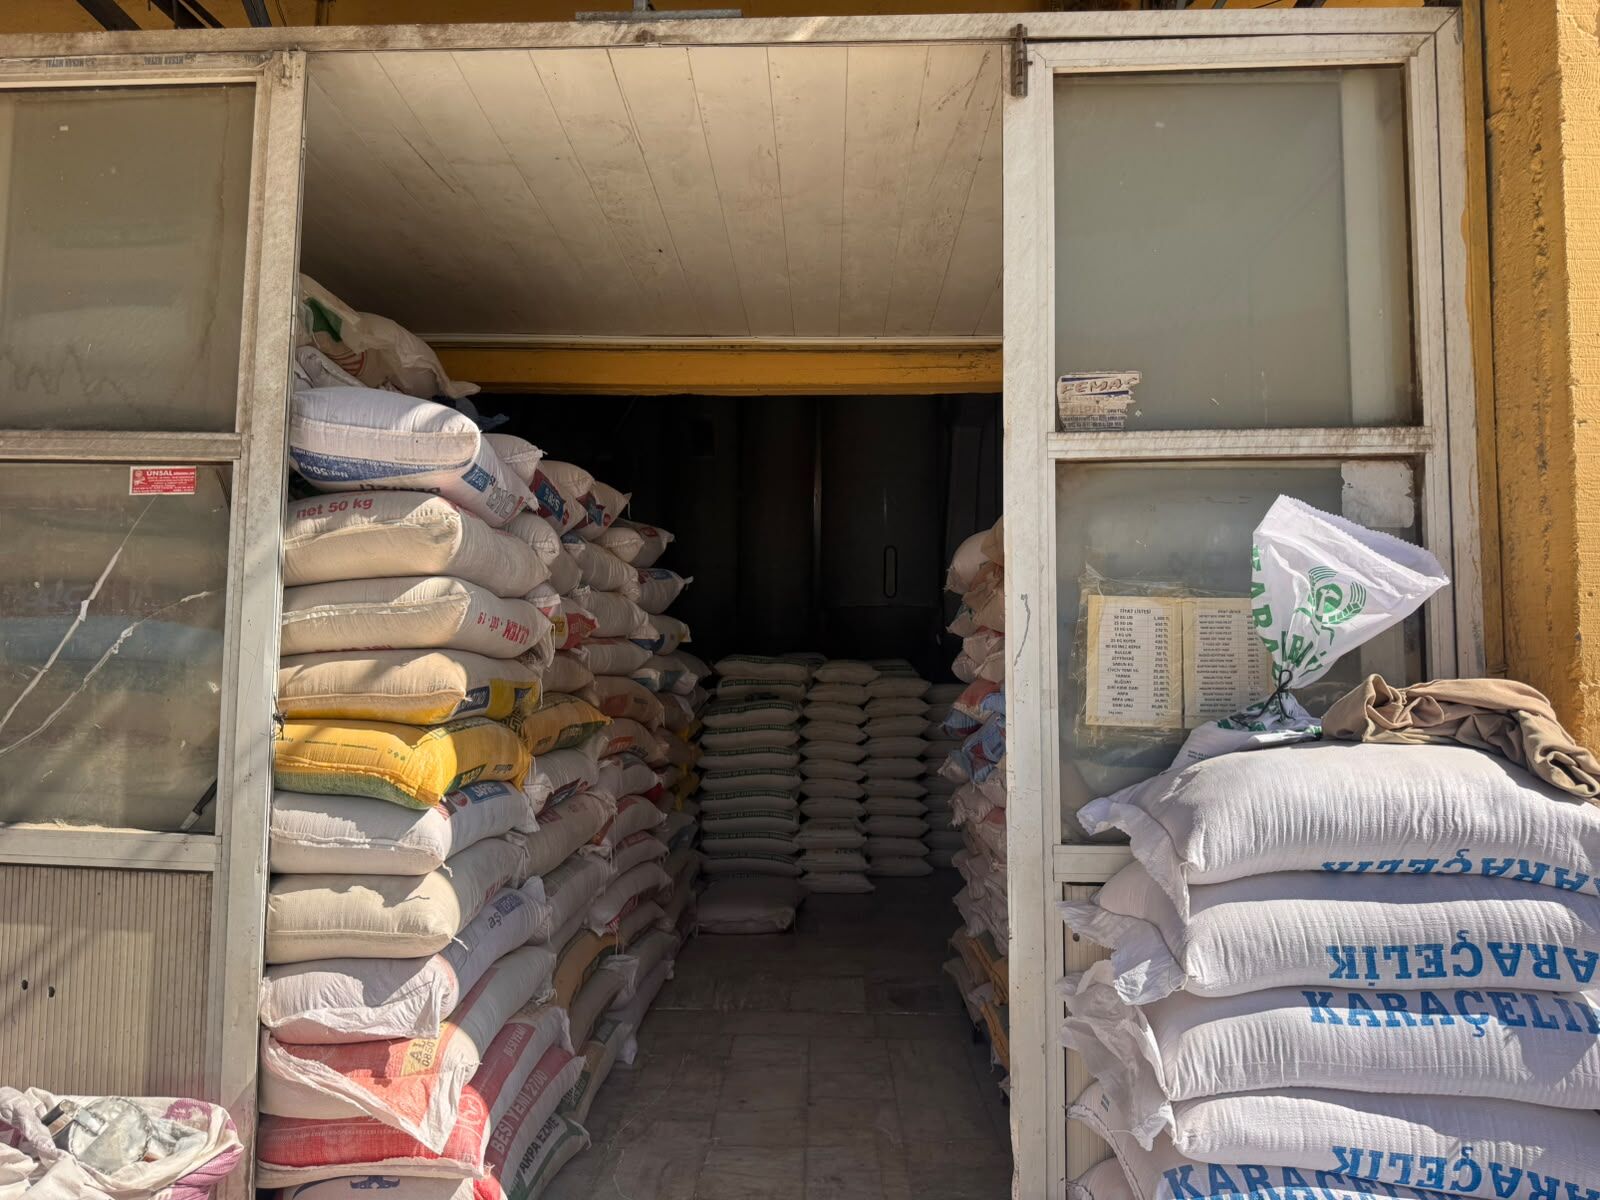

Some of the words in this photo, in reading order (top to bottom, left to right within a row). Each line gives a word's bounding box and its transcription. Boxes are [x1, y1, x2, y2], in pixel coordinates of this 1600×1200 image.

[296, 503, 323, 519] net
[328, 502, 349, 513] 50
[353, 497, 374, 510] kg
[518, 1140, 542, 1175] ARPA
[538, 1116, 561, 1145] EZME
